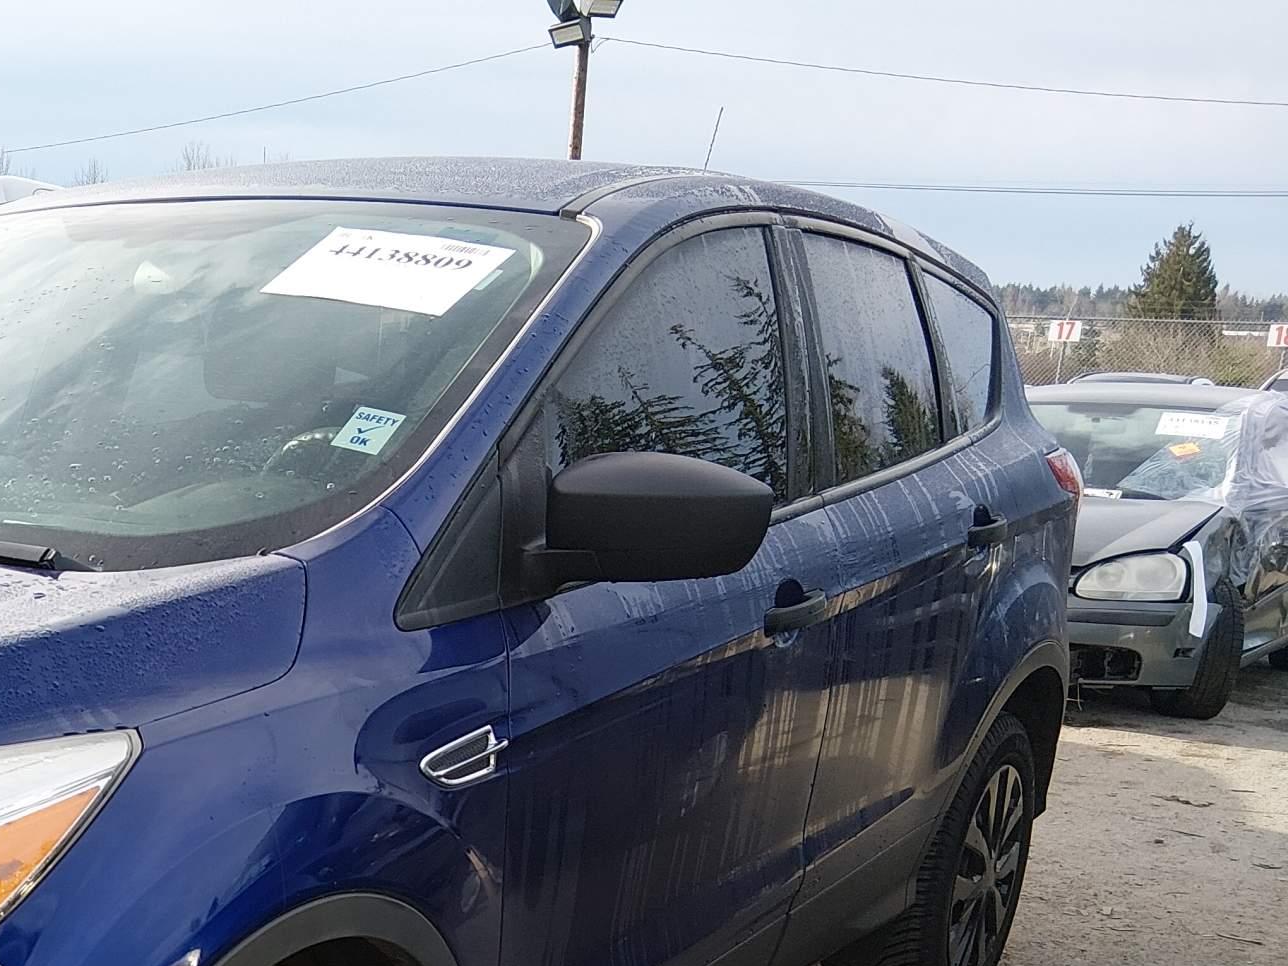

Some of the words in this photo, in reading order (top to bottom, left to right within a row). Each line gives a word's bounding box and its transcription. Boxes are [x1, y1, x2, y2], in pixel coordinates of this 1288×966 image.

[329, 243, 473, 270] 44138809
[1057, 321, 1076, 340] 17
[355, 411, 400, 427] SAFETY
[349, 435, 371, 447] OK
